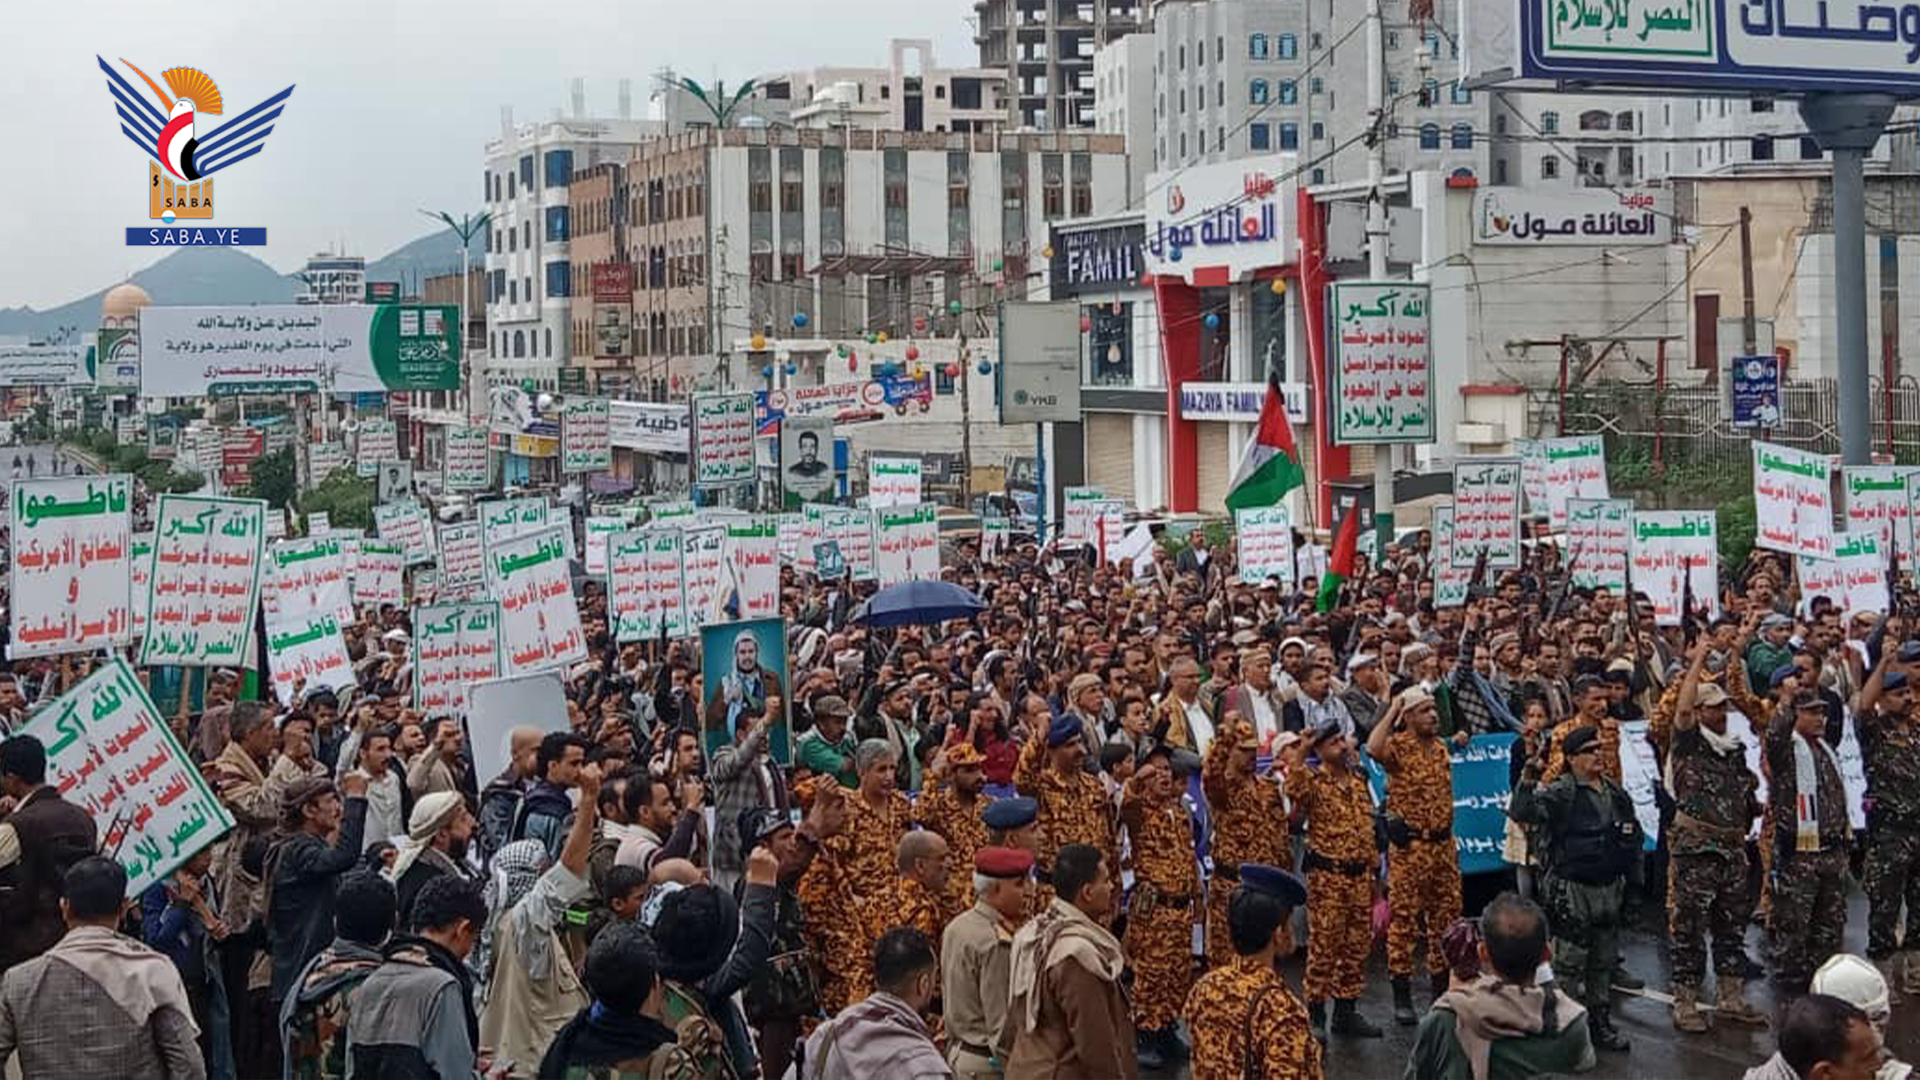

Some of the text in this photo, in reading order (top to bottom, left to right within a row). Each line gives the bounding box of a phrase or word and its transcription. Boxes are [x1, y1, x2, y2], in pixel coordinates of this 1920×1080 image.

[1202, 203, 1275, 246] العائلة
[1511, 211, 1655, 241] العائلة مول
[1067, 244, 1136, 285] FAMIL
[1340, 289, 1429, 324] الله أكبر
[197, 316, 217, 330] الله
[217, 315, 252, 331] ولاية
[1397, 328, 1427, 348] لموت
[1397, 355, 1427, 374] لموت
[1288, 391, 1302, 414] LL
[1407, 380, 1426, 398] للعنة
[1397, 403, 1427, 433] لنصر
[1757, 447, 1827, 480] قاطعوا
[1847, 471, 1906, 497] طعوا
[17, 480, 127, 529] قاطعوا
[163, 504, 257, 542] الله أكبر
[1633, 514, 1711, 542] قاطعوا
[16, 530, 128, 574] البضائع الأمريكية
[272, 537, 340, 569] قاطعوا
[493, 532, 564, 581] قاطعوا
[653, 532, 679, 552] الله
[67, 575, 80, 604] و
[17, 606, 127, 650] الإسرائيلية
[270, 613, 339, 657] قاطعوا
[420, 607, 496, 642] الله أكبر
[148, 630, 243, 662] النصر للإسلام
[46, 673, 132, 772] الله أك
[55, 741, 105, 792] لأمريك
[167, 797, 215, 859] النصر
